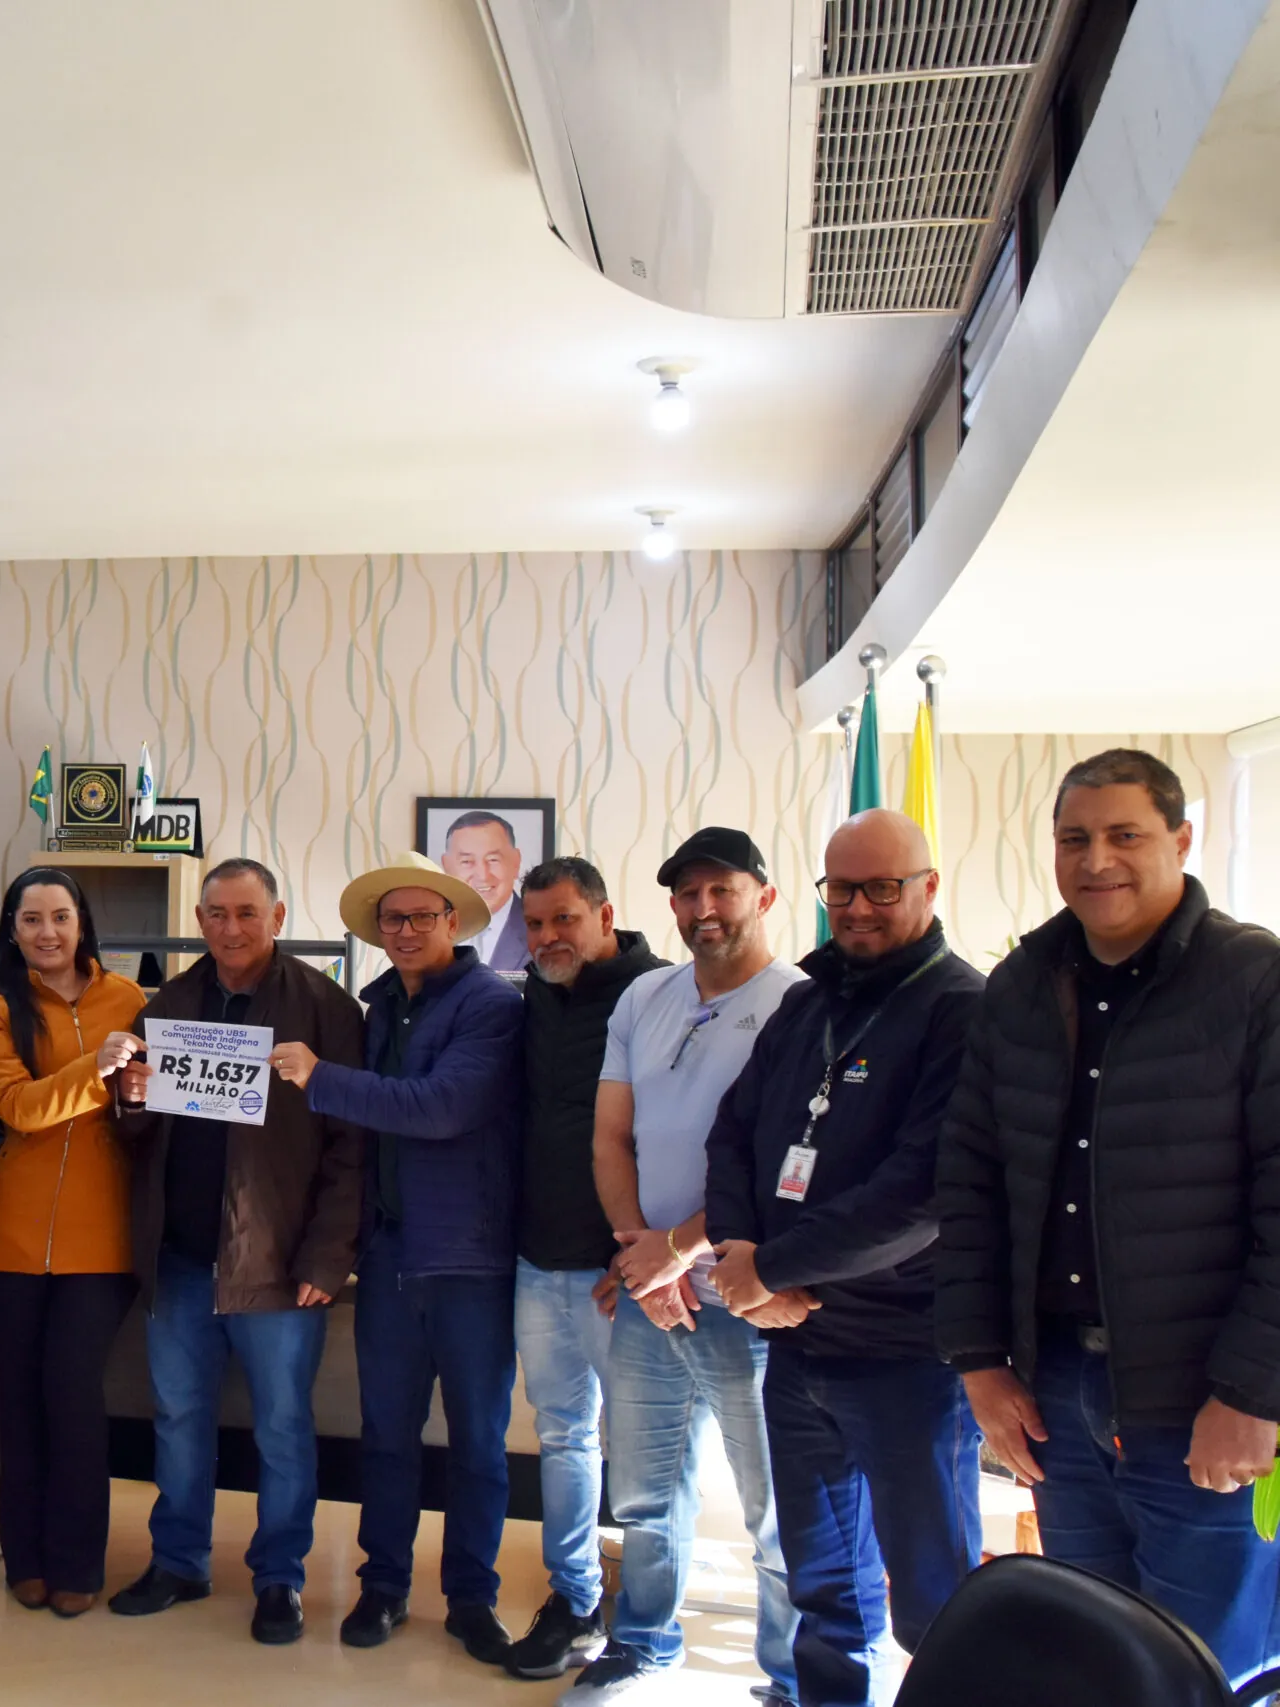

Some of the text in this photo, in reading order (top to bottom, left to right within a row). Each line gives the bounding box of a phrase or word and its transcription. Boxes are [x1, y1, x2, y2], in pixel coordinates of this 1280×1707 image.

[135, 814, 191, 841] MDB
[161, 1030, 218, 1042] Comunidade
[173, 1024, 248, 1038] Construção UBSI
[182, 1038, 215, 1049] Tekoha
[159, 1054, 261, 1085] R$ 1.637
[175, 1080, 239, 1098] MILHÃO
